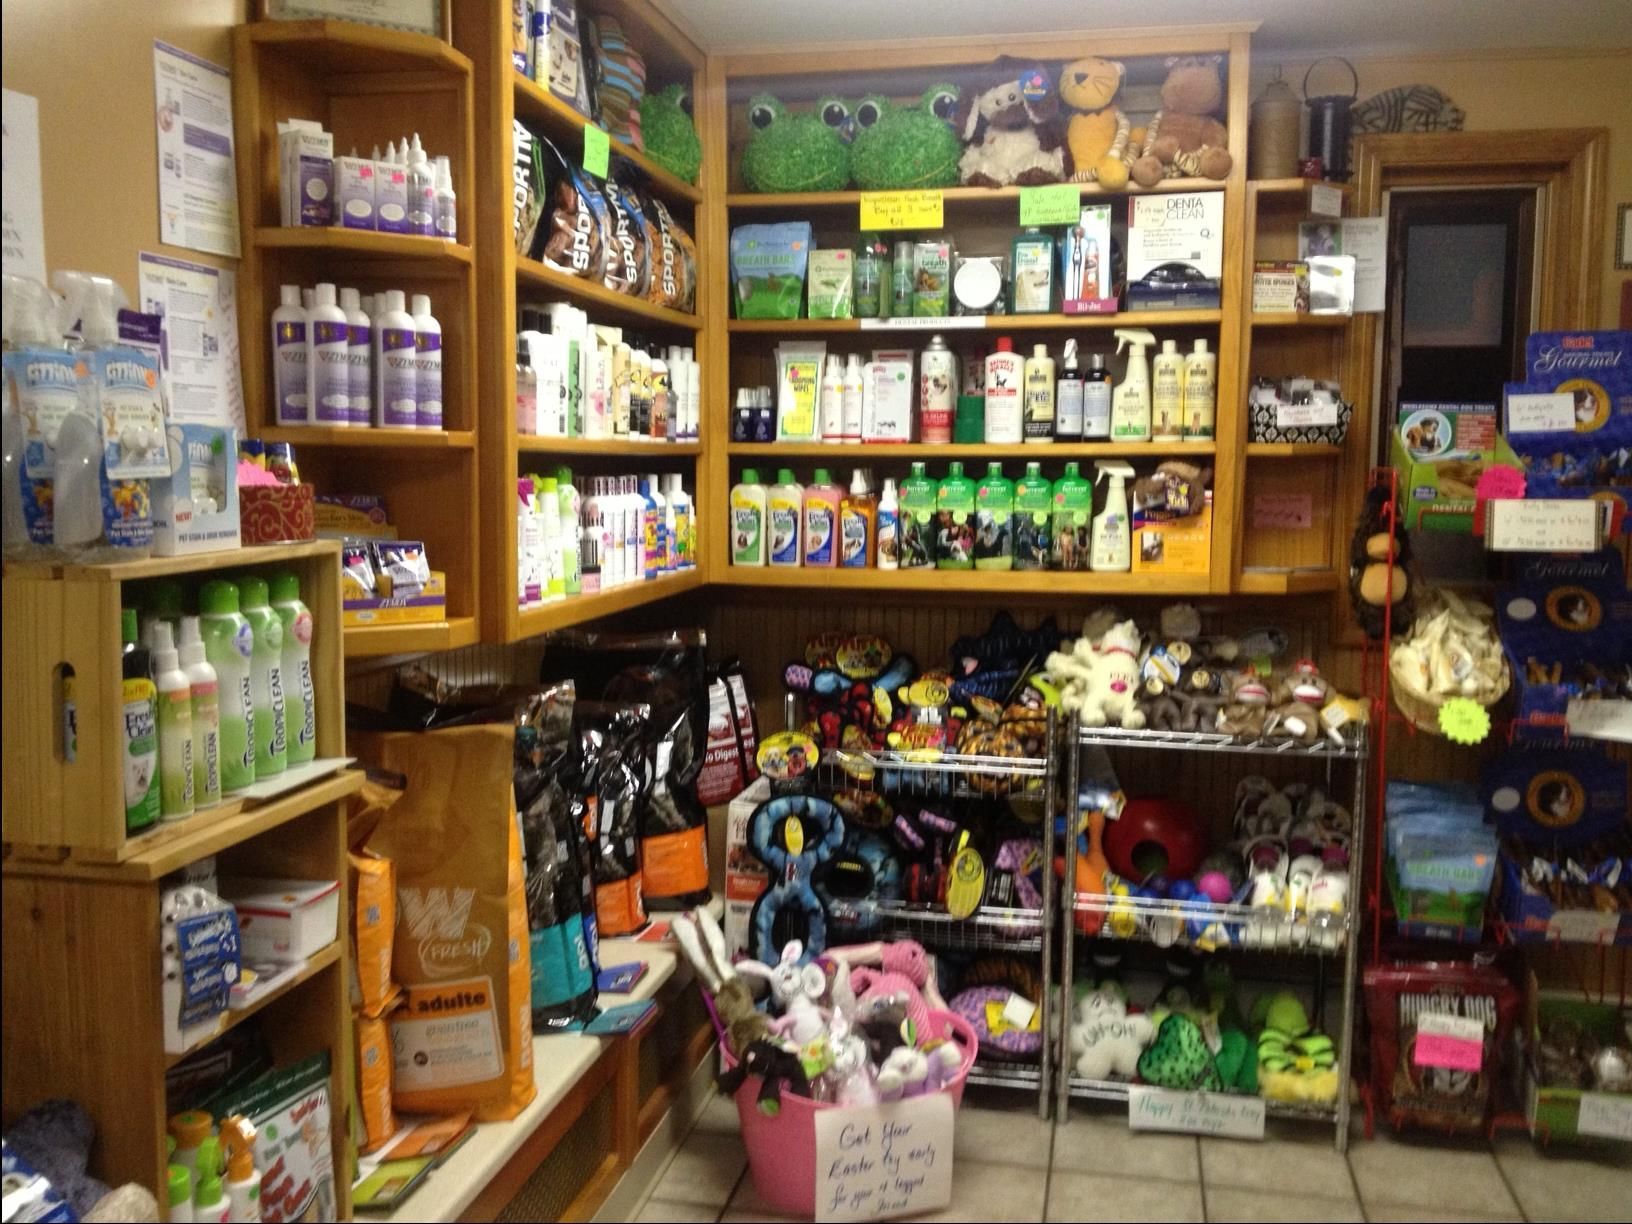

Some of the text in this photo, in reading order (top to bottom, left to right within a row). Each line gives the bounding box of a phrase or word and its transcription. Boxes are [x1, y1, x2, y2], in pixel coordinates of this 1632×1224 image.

[1166, 197, 1204, 209] DENTA
[1166, 209, 1205, 220] CLEAN
[1533, 345, 1623, 373] Gourmet
